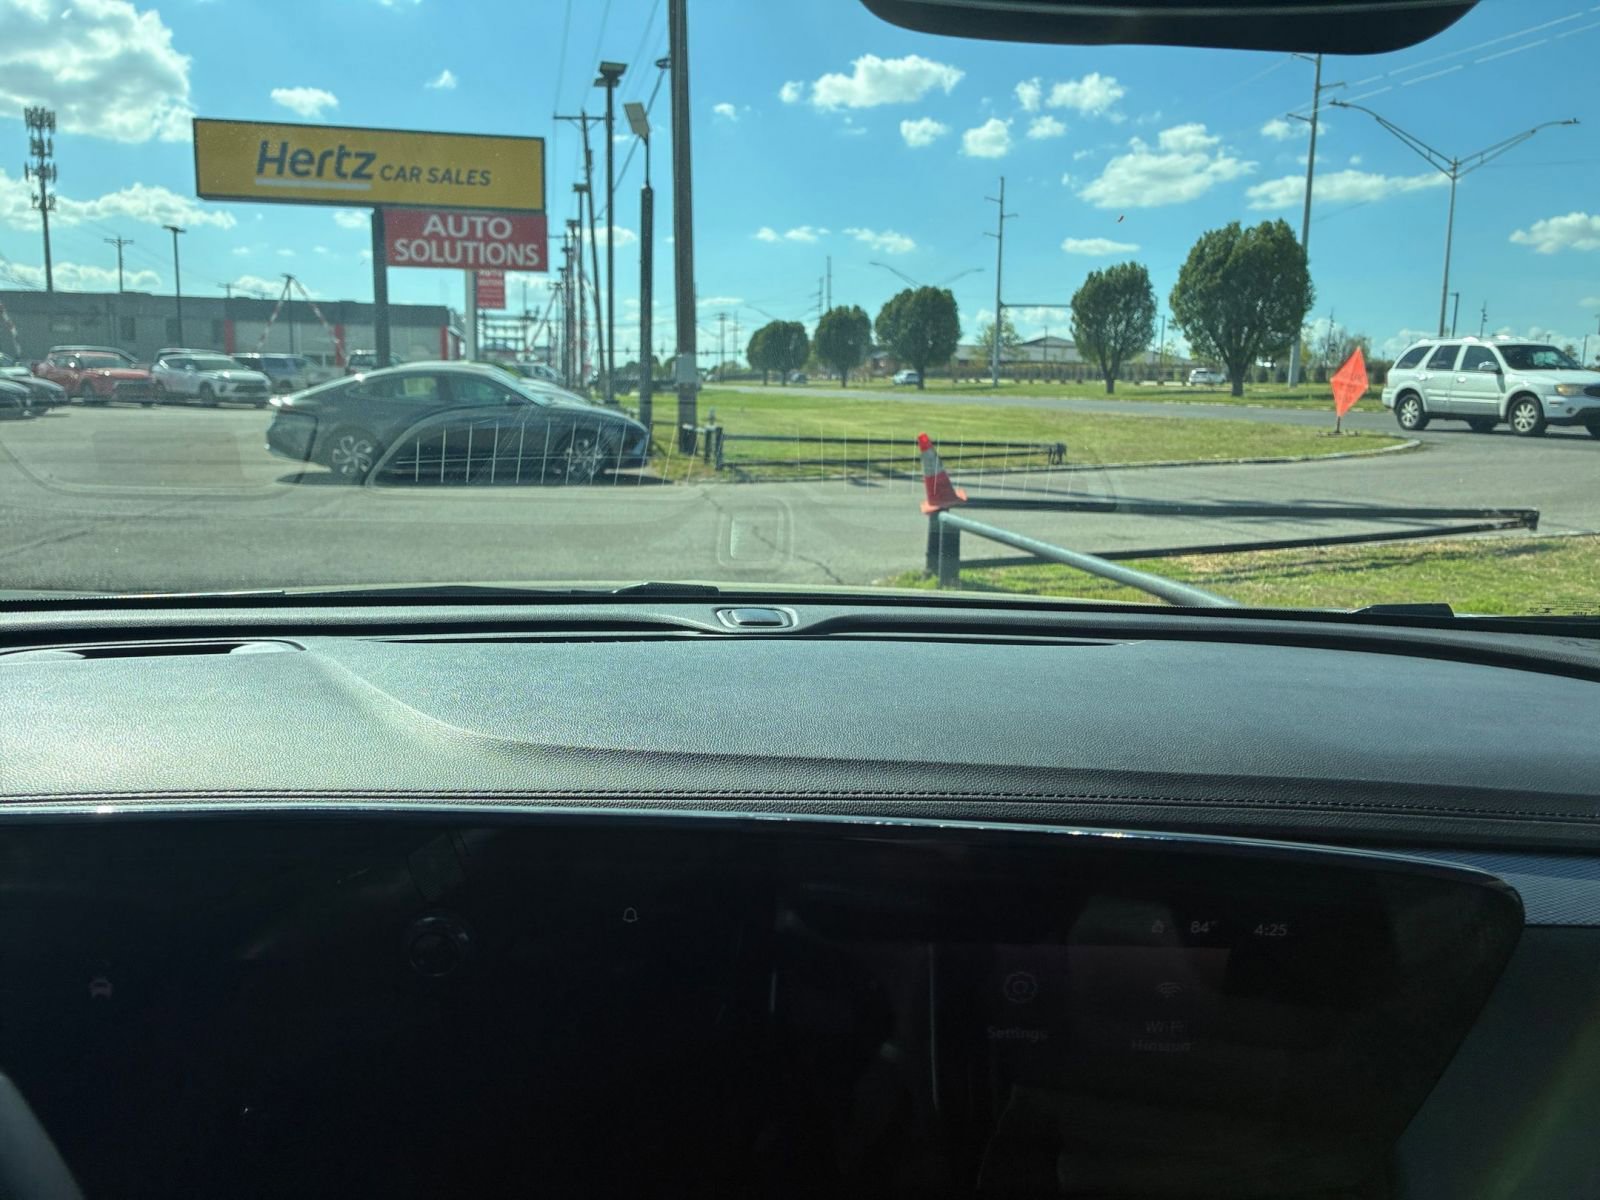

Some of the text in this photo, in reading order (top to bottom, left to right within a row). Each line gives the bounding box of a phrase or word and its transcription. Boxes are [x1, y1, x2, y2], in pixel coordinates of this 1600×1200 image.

[256, 140, 492, 187] Hertz CAR SALES
[422, 213, 513, 240] AUTO
[394, 239, 540, 267] SOLUTIONS
[1253, 923, 1288, 937] 4:25
